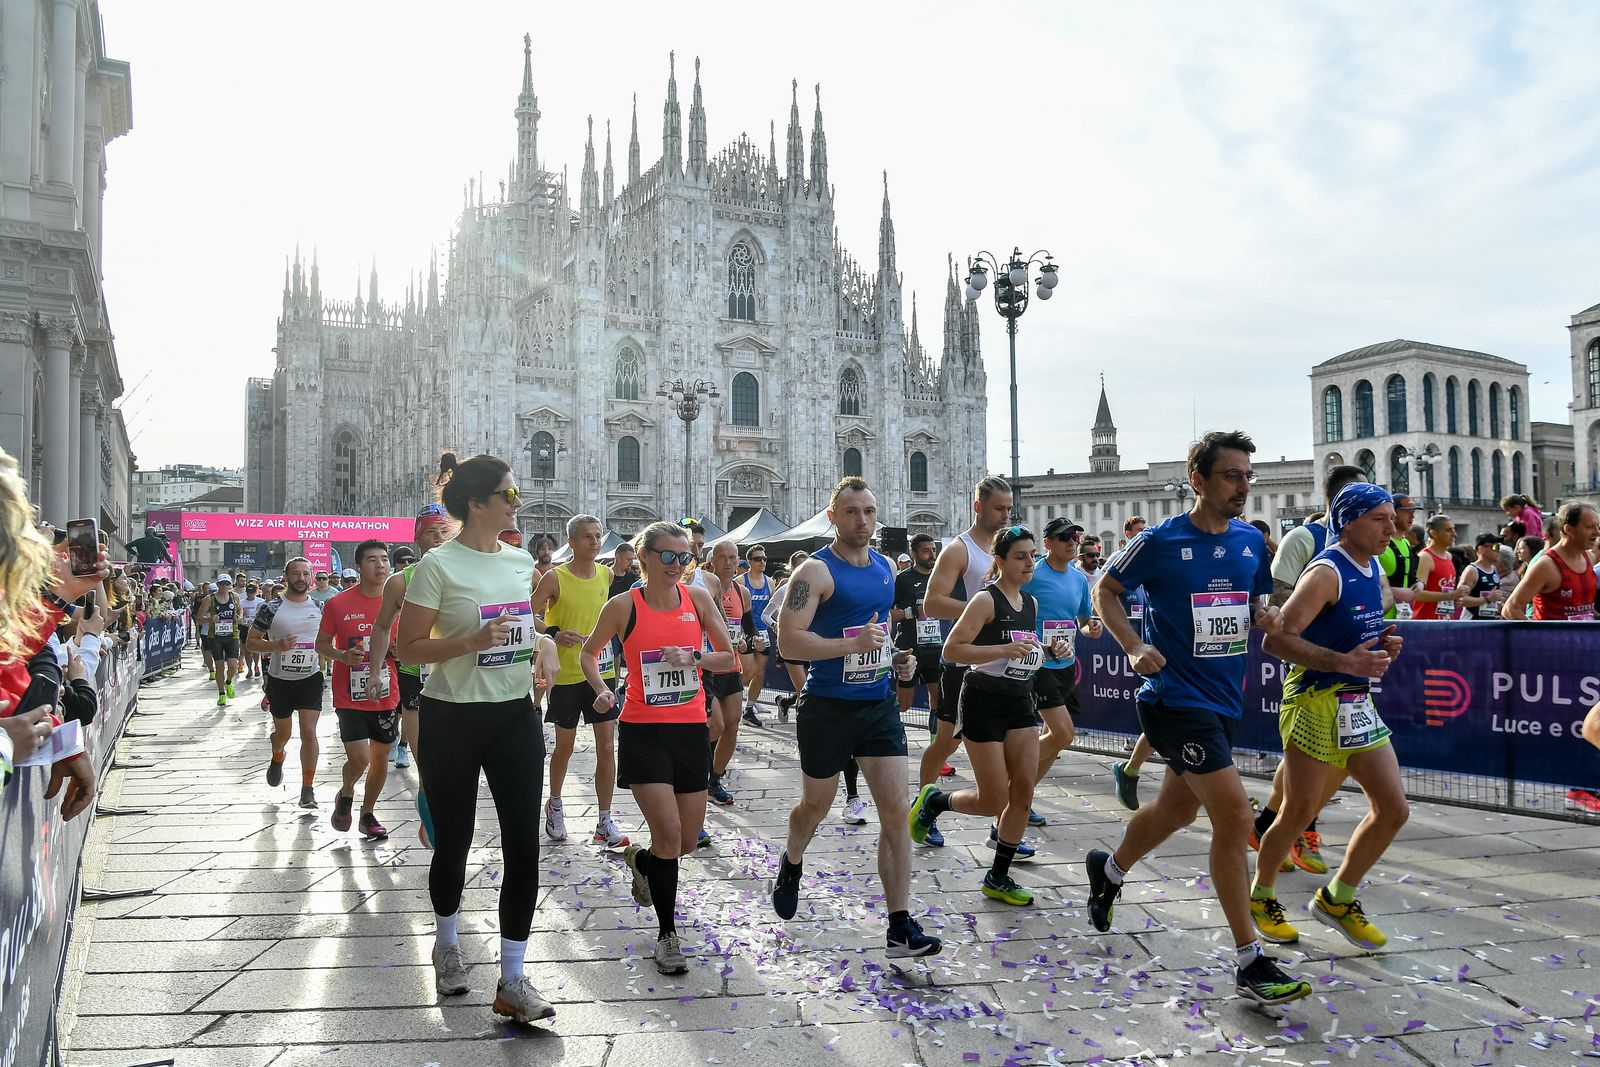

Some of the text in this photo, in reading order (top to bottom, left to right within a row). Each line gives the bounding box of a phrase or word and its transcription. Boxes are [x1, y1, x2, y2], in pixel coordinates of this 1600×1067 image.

[235, 518, 390, 530] WIZZ AIR MILANO MARATHON
[298, 531, 330, 539] START
[1207, 616, 1239, 636] 7825
[1206, 643, 1223, 651] asics
[291, 654, 306, 664] 267
[1092, 653, 1142, 677] PUL
[657, 669, 686, 689] 7791
[1093, 684, 1120, 699] Luce
[1122, 688, 1131, 700] e
[1492, 672, 1600, 707] PULS
[1491, 714, 1542, 736] Luce
[1549, 722, 1563, 737] e
